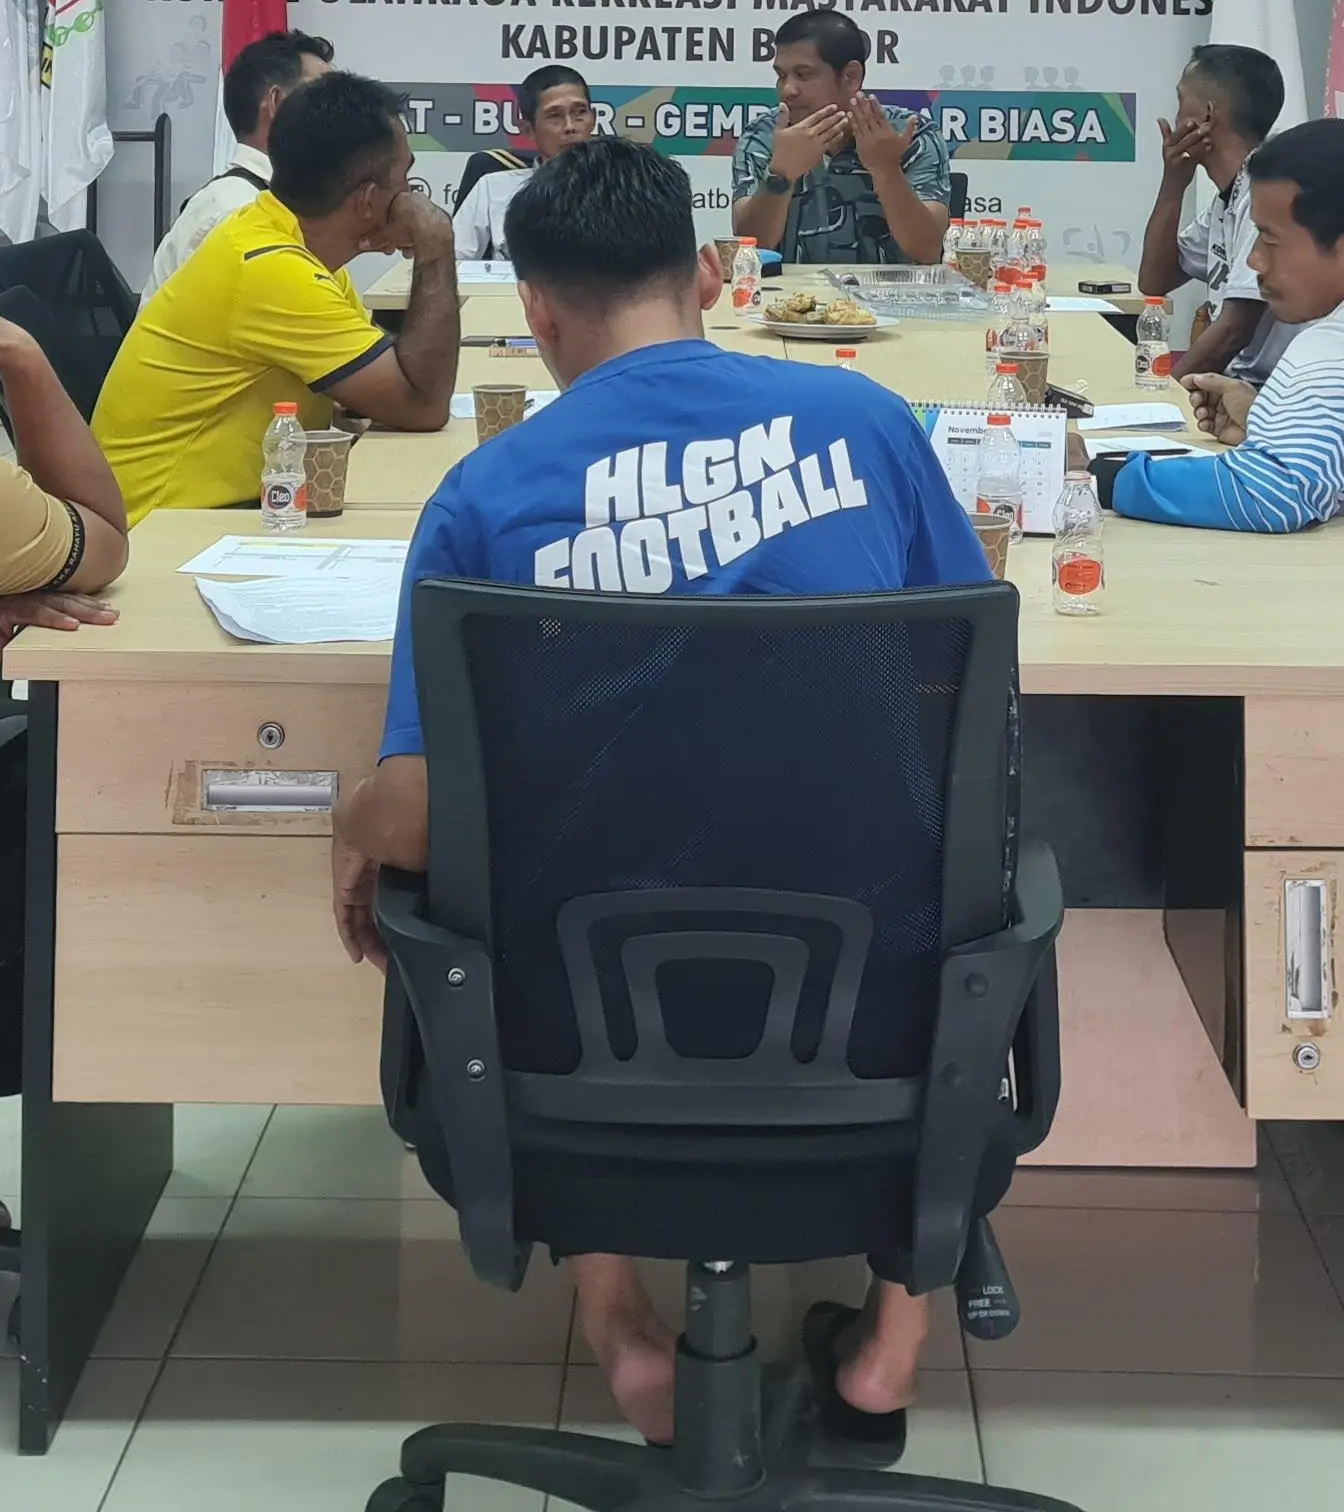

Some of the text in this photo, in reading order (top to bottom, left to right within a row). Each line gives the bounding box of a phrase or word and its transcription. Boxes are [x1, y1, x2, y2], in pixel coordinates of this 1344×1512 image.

[501, 24, 735, 62] KABUPATEN
[978, 108, 1108, 144] BIASA
[947, 425, 988, 435] Novembe
[585, 415, 797, 528] HLGN
[271, 490, 291, 503] Cleo
[535, 438, 868, 594] FOOTBALL
[982, 1284, 1005, 1295] LOCK
[968, 1298, 991, 1308] FREE
